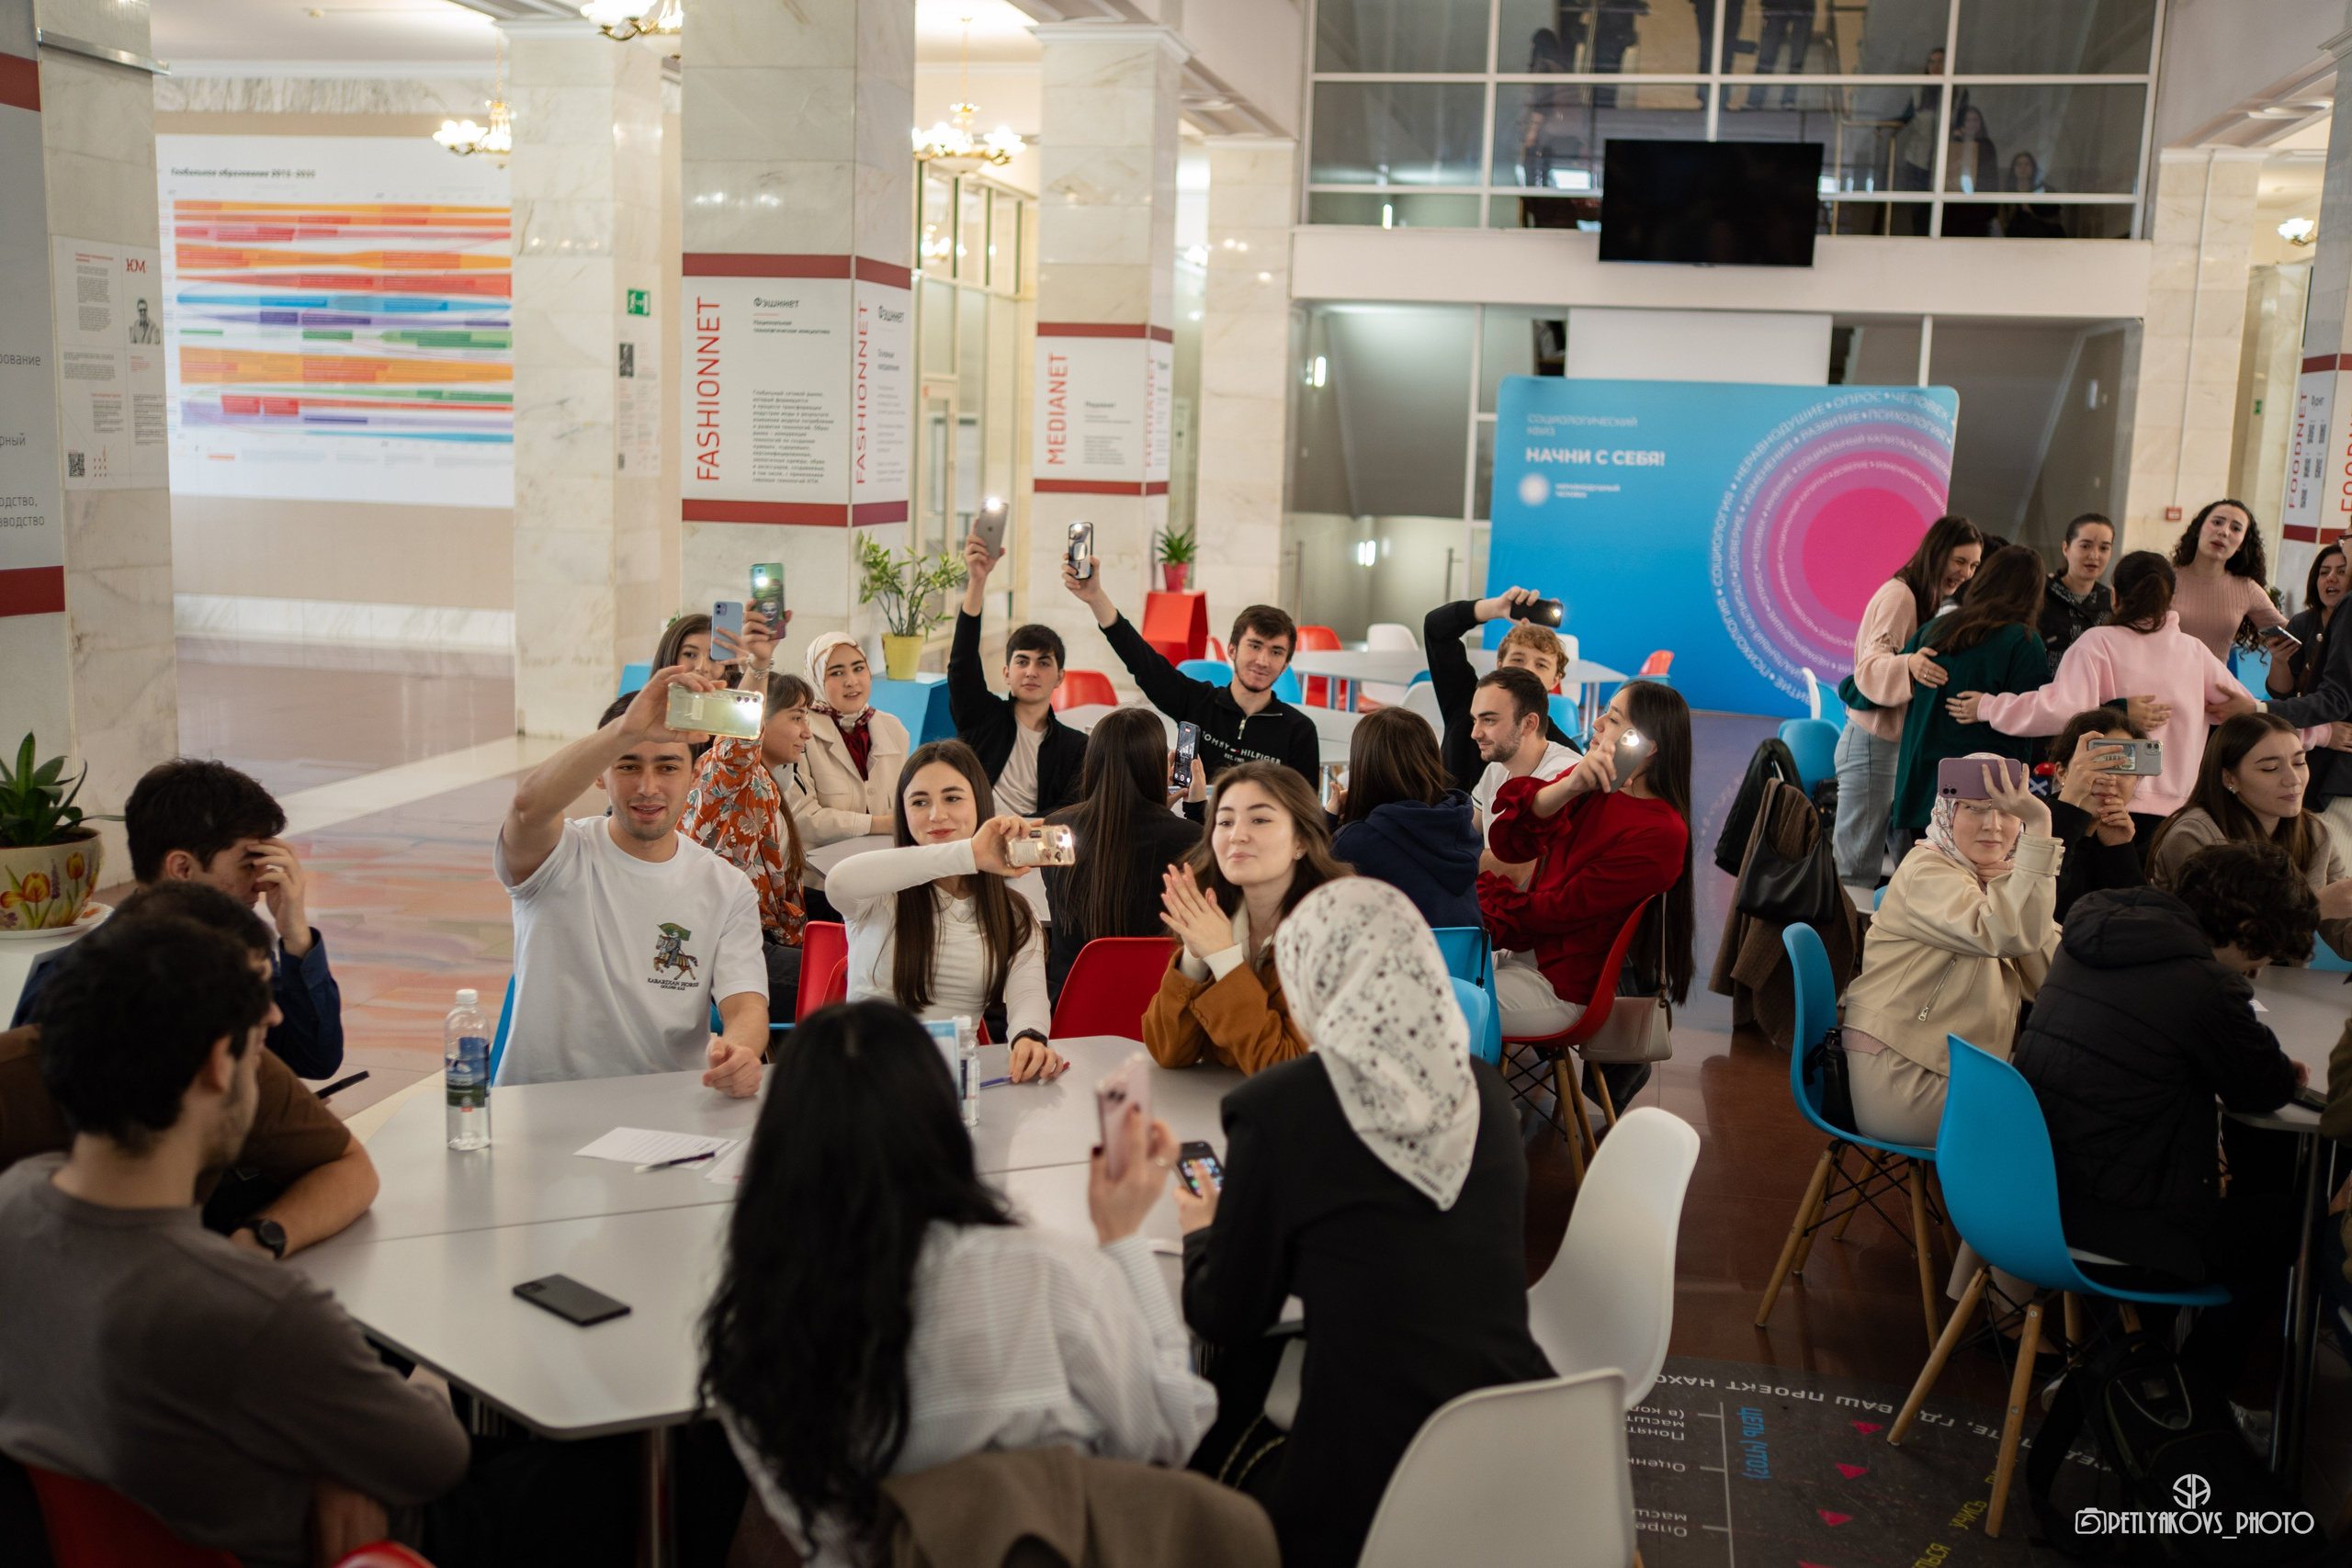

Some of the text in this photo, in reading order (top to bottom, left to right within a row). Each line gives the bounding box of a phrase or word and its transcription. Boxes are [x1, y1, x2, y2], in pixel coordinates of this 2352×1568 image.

[696, 295, 721, 481] FASHIONNET
[856, 299, 868, 484] FASHIONNET
[1046, 352, 1068, 466] MEDIANET
[1832, 391, 1882, 408] ОПРОС
[1891, 390, 1952, 420] ЧЕЛОВЕК
[1527, 413, 1638, 427] СОЦИОЛОГИЧЕСКИЙ
[1798, 411, 1860, 441] РАЗВИТИЕ
[1732, 400, 1826, 483] НЕРАВНОДУШИЕ
[2289, 390, 2307, 509] FOODNET
[1525, 446, 1666, 467] НАЧНИ С СЕБЯ!
[1711, 489, 1735, 587] СОЦИОЛОГИЯ
[1714, 595, 1772, 678] ПСИХОЛОГИЯ
[1240, 749, 1282, 765] HILFIGER
[647, 977, 680, 987] KABARDIAN
[1654, 1374, 1715, 1388] НАХО
[1725, 1381, 1825, 1403] ПРОЕКТ
[1835, 1395, 1894, 1415] ВАШ
[1625, 1415, 1685, 1427] масшт
[1736, 1406, 1765, 1438] ЦЕЛЬ
[1914, 1409, 1955, 1428] ГД
[1625, 1426, 1685, 1441] Понят
[1626, 1457, 1686, 1472] Оценк
[1632, 1507, 1688, 1522] масш
[1948, 1499, 1988, 1531] УЧИСЬ
[1634, 1521, 1688, 1538] Опре
